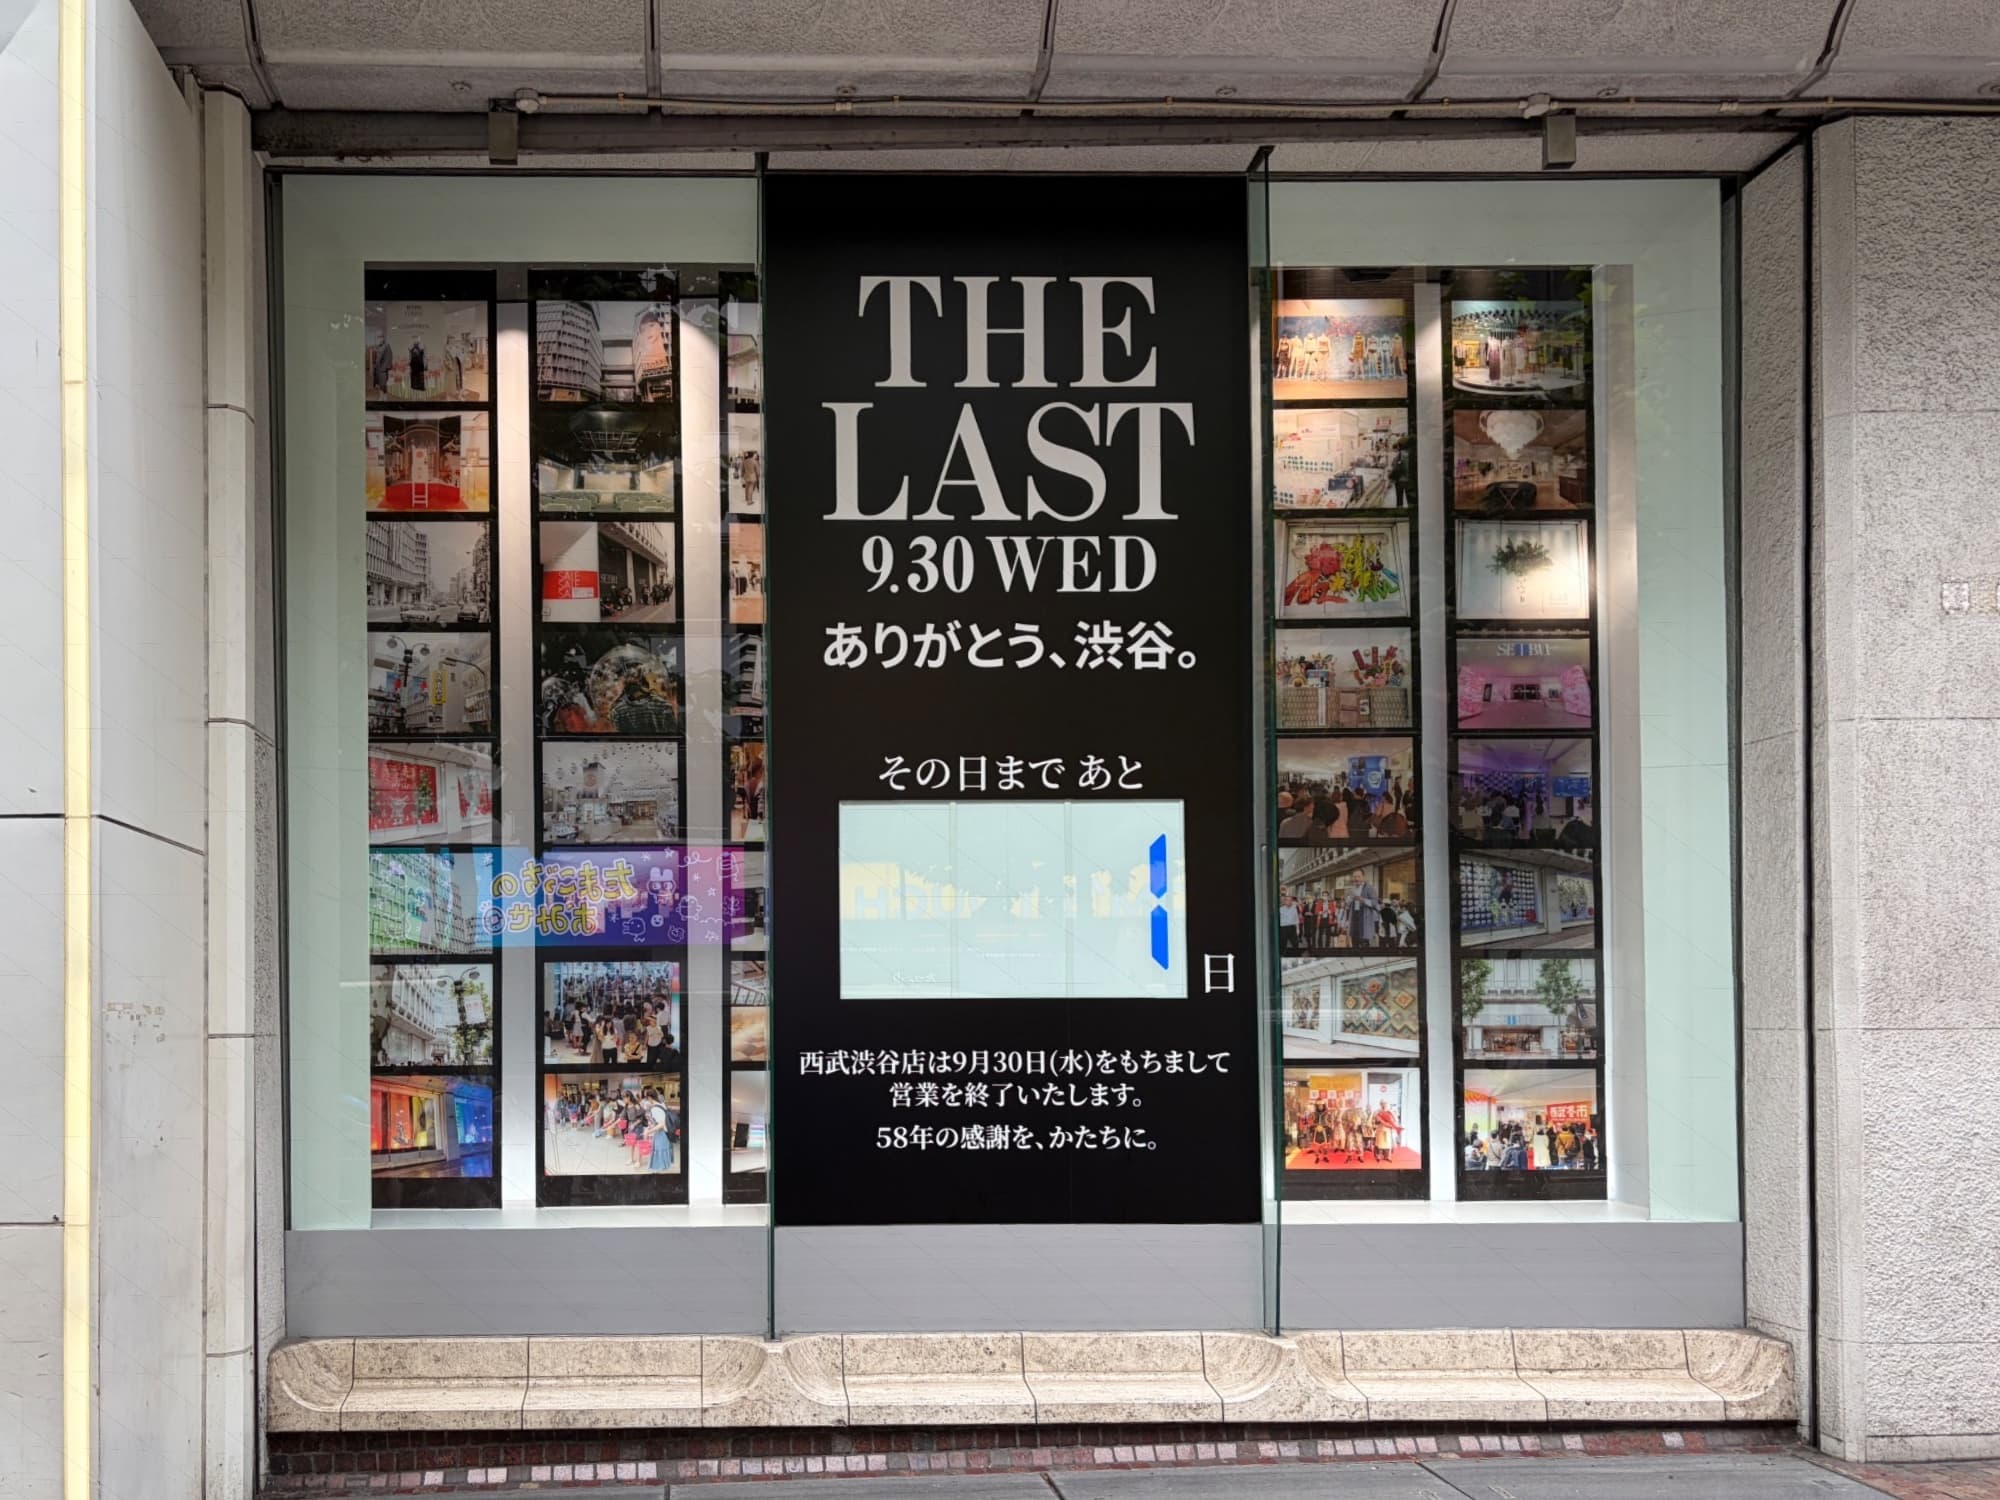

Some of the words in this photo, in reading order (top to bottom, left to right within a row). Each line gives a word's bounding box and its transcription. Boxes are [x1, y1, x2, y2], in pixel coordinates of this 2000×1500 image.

[858, 276, 1157, 387] THE
[822, 402, 1194, 521] LAST
[863, 536, 974, 593] 9.30
[986, 536, 1156, 592] WED
[824, 620, 1195, 669] ありがとう、渋谷。
[879, 756, 1065, 791] その日まで
[1079, 755, 1142, 790] あと
[1149, 833, 1169, 970] 1
[1205, 954, 1234, 993] 日
[801, 1049, 1230, 1076] 西武渋谷店は9月30日(水)をもちまして
[890, 1082, 1141, 1107] 営業を終了いたします。
[877, 1125, 1156, 1150] 58年の感謝を、かたちに。
